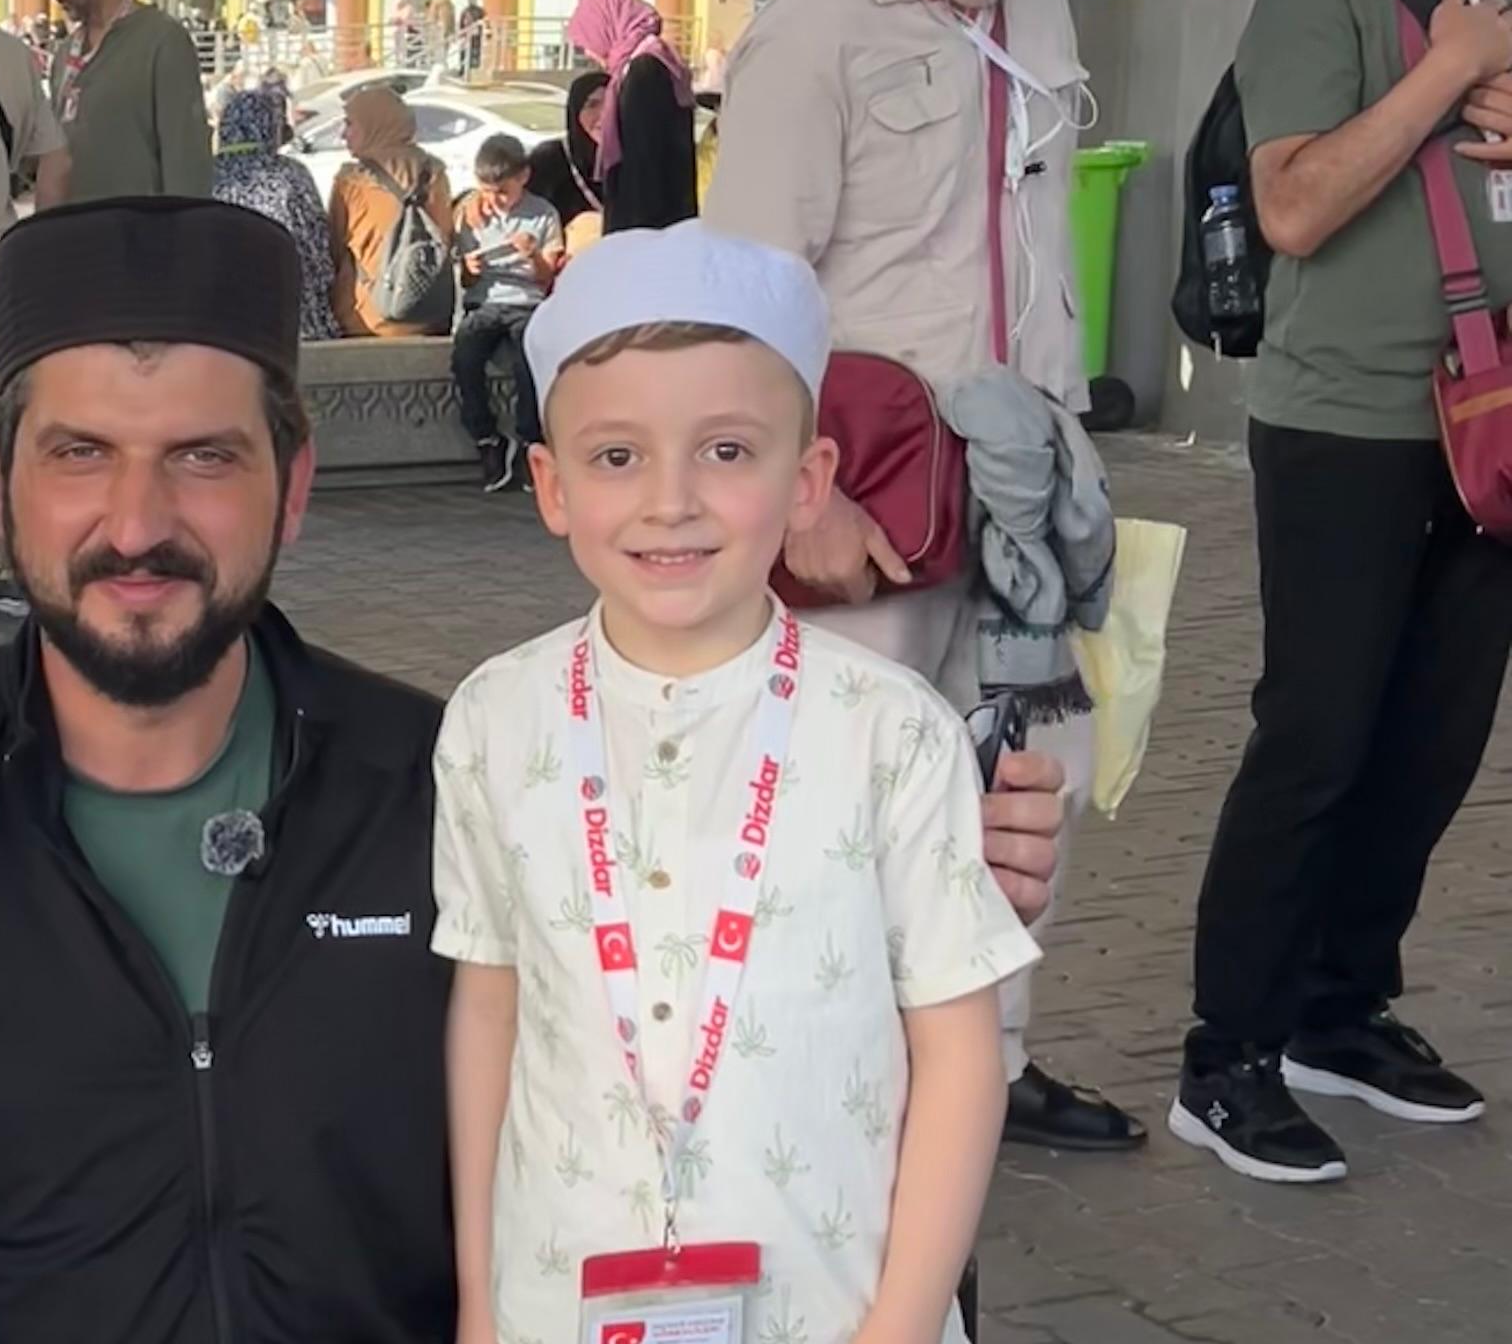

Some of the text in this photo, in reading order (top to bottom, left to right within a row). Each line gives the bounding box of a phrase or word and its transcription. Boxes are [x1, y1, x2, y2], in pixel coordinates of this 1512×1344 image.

[741, 754, 779, 846] Dizdar
[585, 808, 617, 897] Dizdar
[331, 912, 411, 938] hummel
[690, 995, 729, 1091] Dizdar
